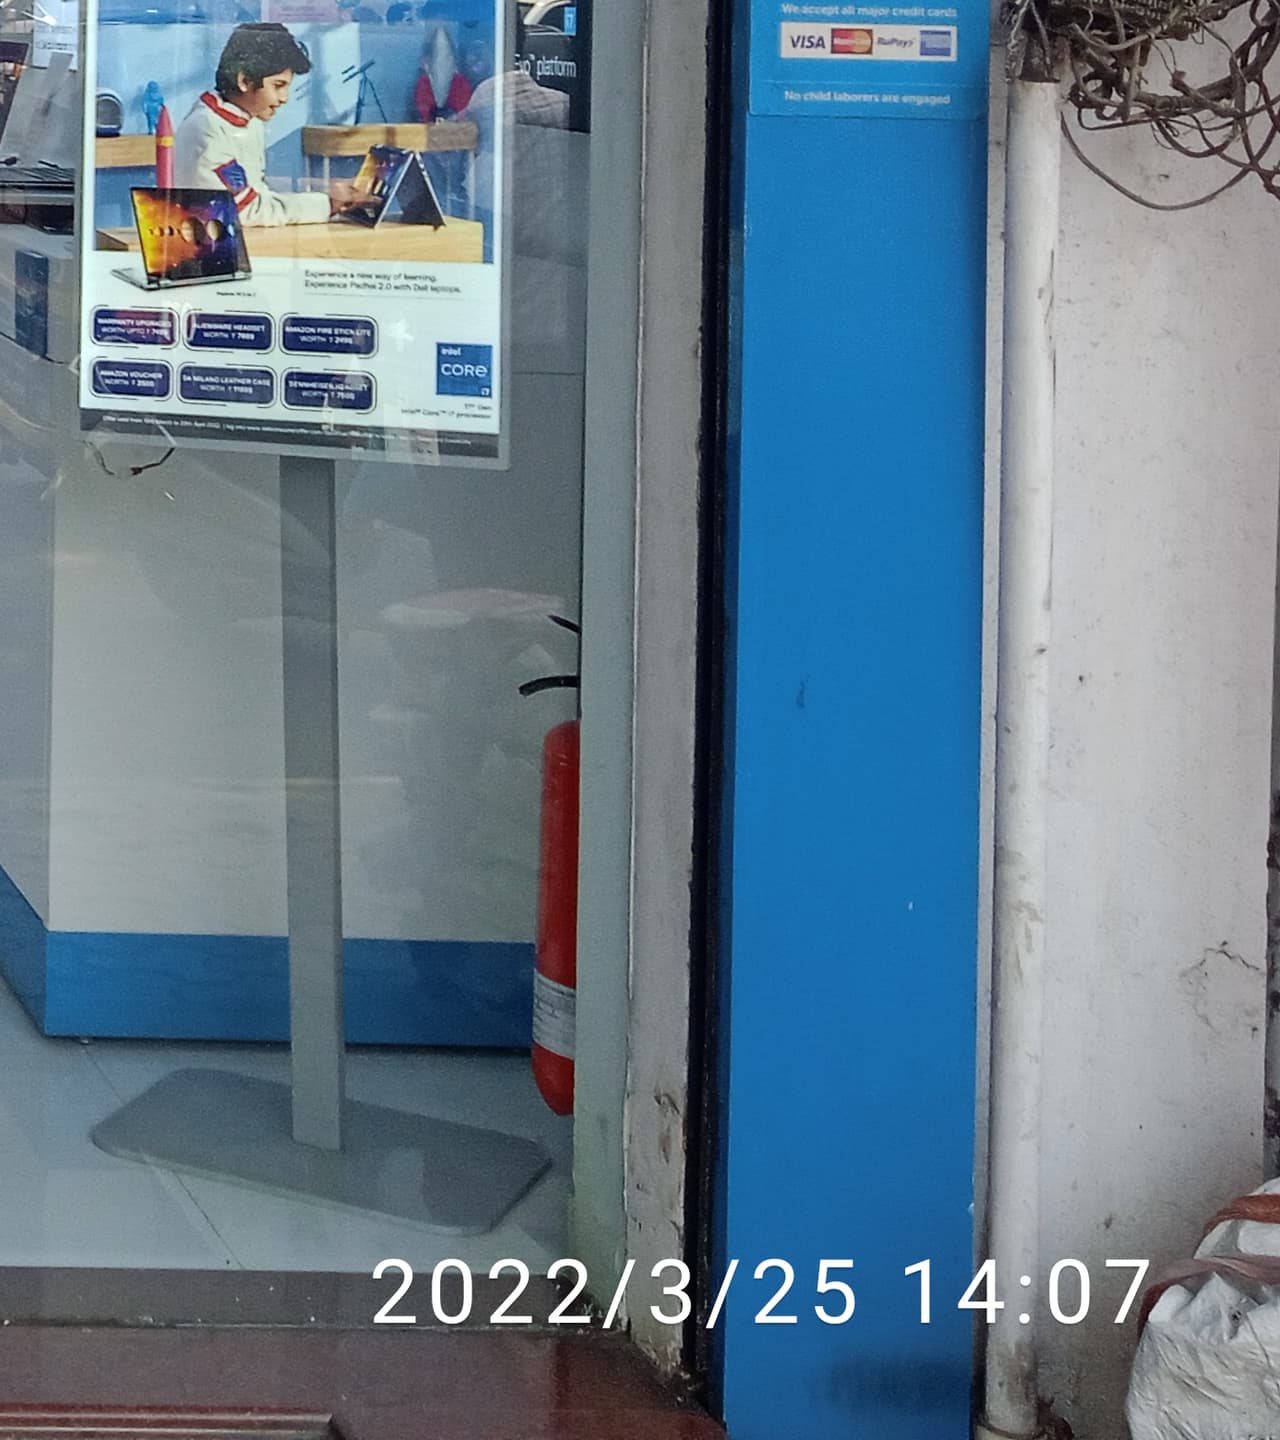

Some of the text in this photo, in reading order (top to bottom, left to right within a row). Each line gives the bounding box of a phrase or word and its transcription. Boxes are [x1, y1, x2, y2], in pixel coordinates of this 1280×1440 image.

[781, 3, 958, 18] We accept all major credit cards
[791, 35, 826, 49] VISA
[536, 57, 577, 79] platform
[785, 90, 951, 106] No child laborers are engaged
[305, 270, 348, 280] Experience
[305, 280, 348, 290] Experience
